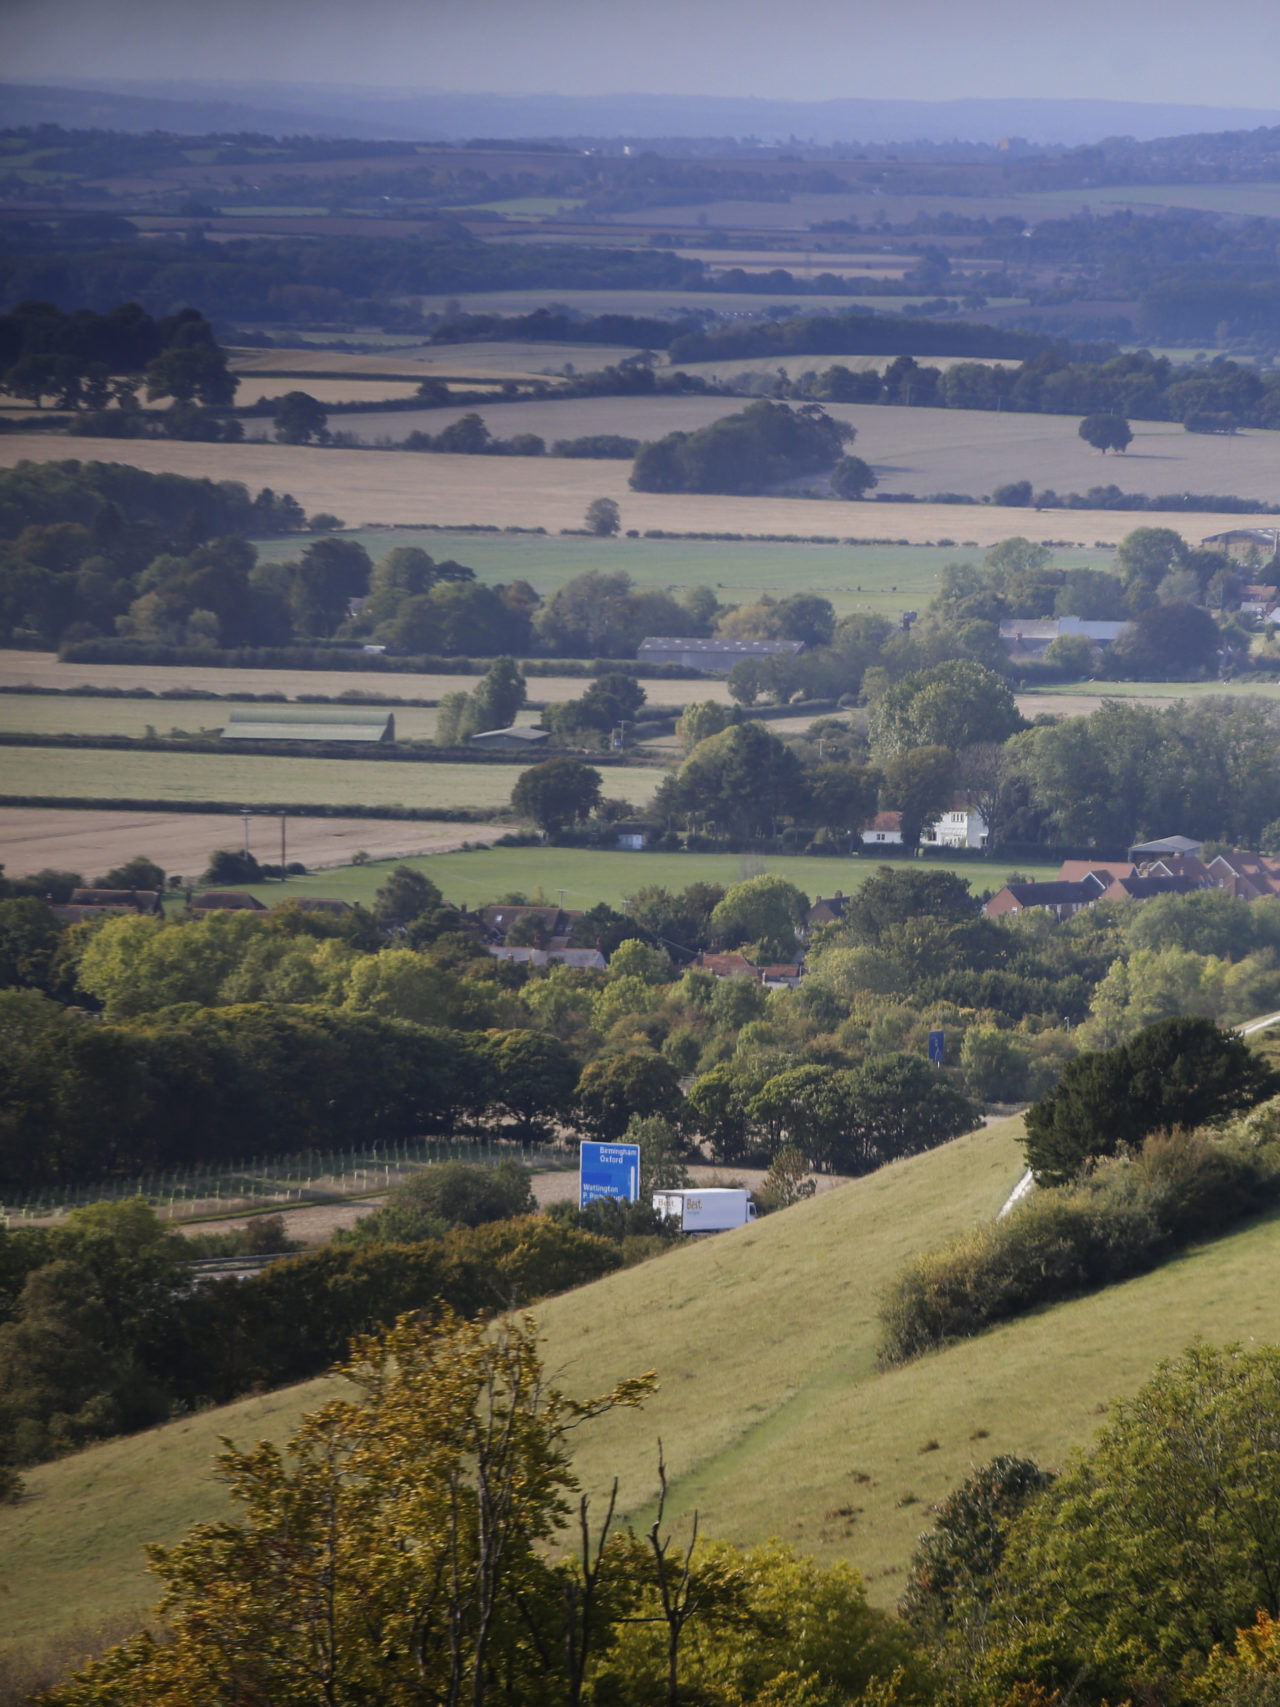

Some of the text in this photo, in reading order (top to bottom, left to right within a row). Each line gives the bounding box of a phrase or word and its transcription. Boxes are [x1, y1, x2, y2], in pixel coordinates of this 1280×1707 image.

[600, 1146, 636, 1156] Birmingham
[600, 1155, 623, 1164] Oxford
[583, 1183, 618, 1193] Watlington
